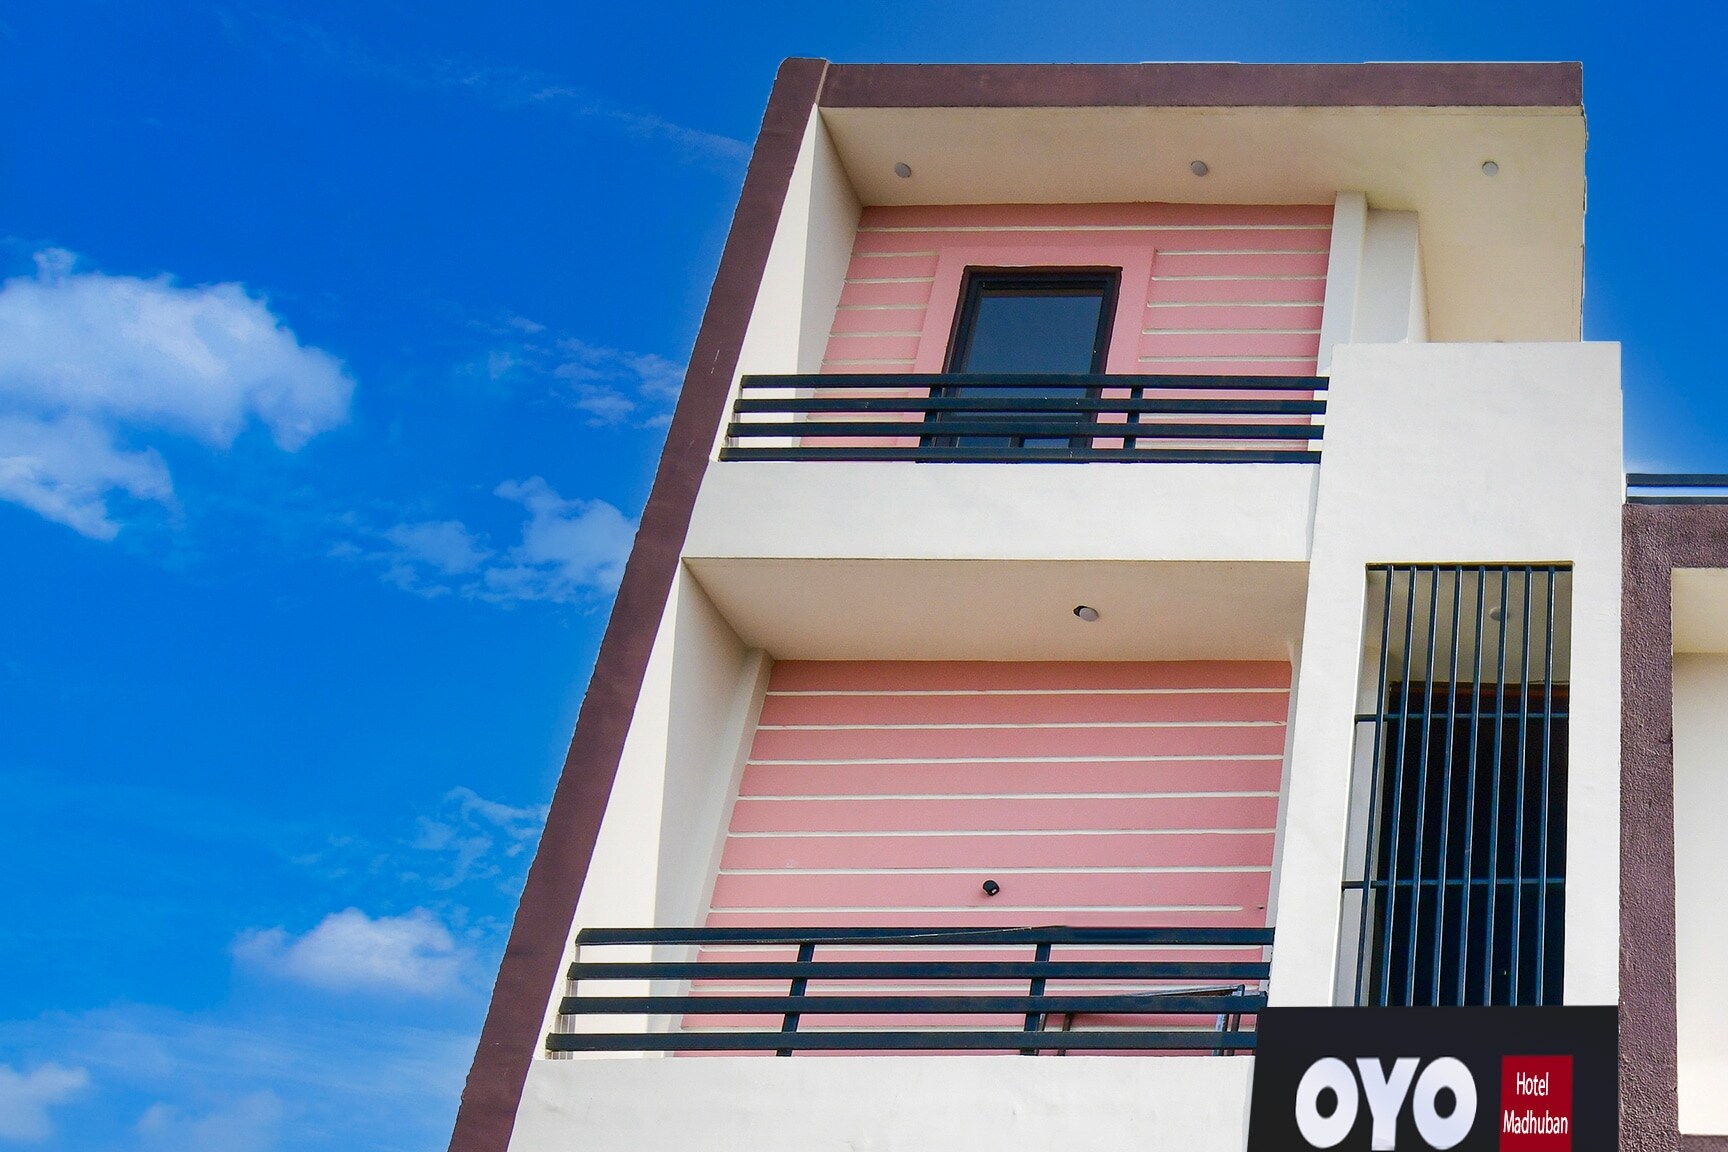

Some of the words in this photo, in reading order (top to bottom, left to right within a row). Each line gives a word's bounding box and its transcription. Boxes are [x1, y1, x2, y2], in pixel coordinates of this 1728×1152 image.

[1516, 1071, 1549, 1097] Hotel
[1295, 1056, 1478, 1152] OYO
[1503, 1109, 1569, 1135] Madhuban
